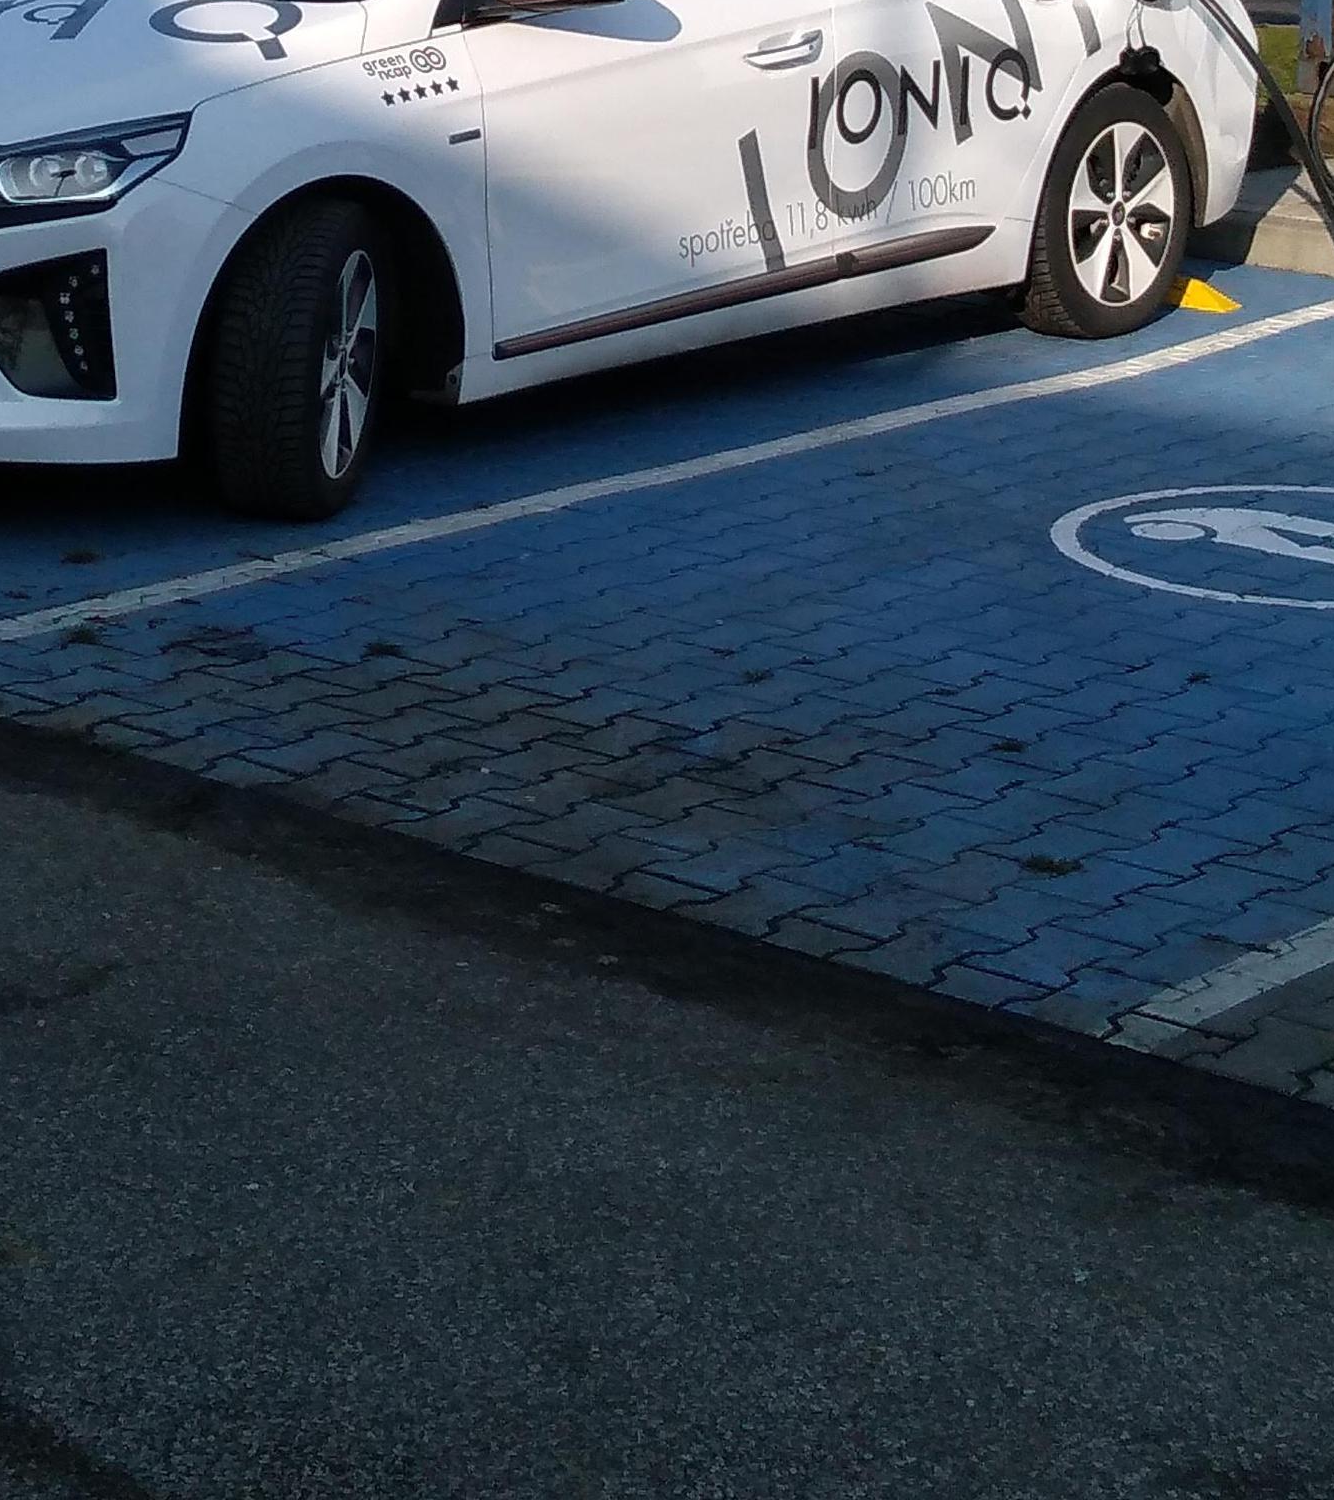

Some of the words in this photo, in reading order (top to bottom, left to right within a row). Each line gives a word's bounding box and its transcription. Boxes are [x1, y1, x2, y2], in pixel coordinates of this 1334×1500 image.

[362, 54, 407, 77] green
[378, 65, 412, 81] ncap
[808, 47, 1032, 150] IONIQ
[679, 211, 776, 267] spotřeba
[785, 199, 829, 239] 11,8
[908, 170, 977, 212] 100km
